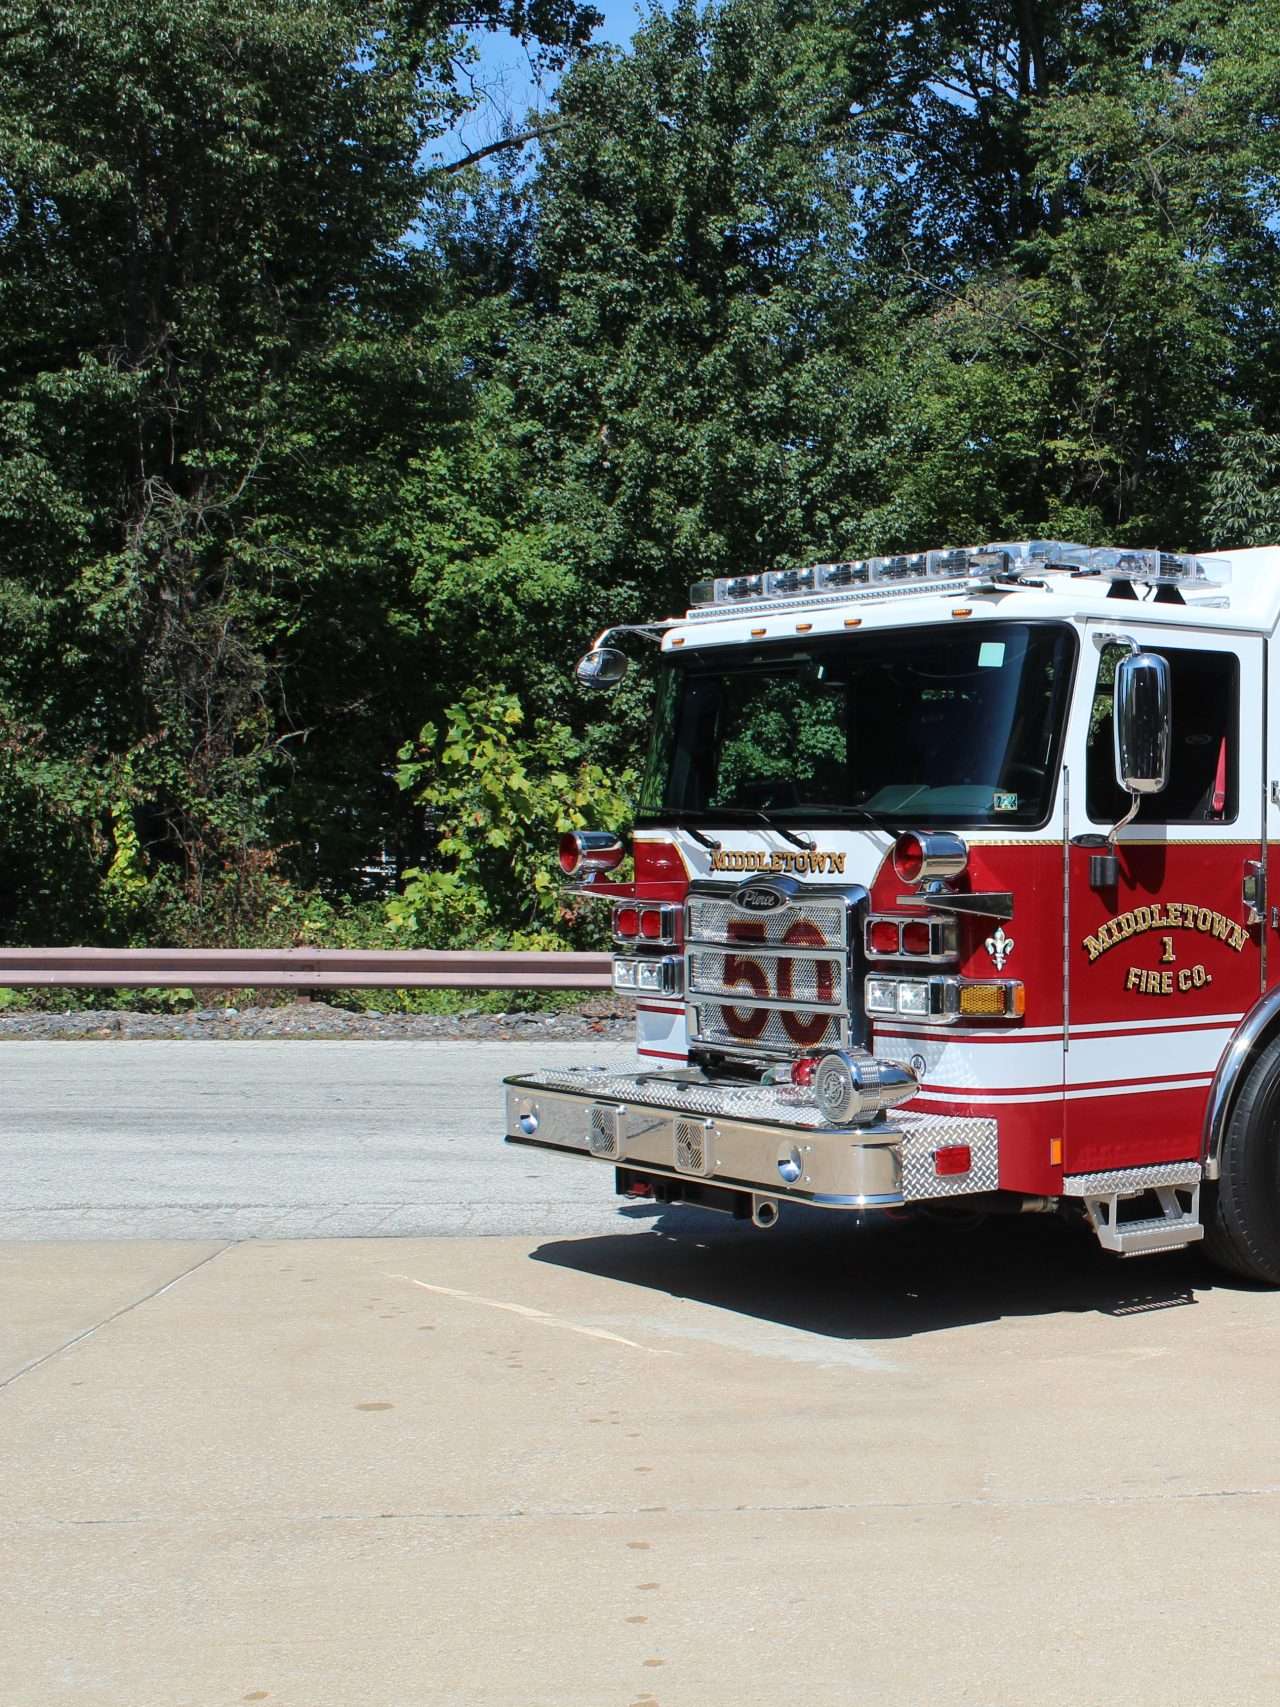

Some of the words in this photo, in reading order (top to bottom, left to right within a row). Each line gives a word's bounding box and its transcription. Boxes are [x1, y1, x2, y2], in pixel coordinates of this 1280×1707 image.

[710, 850, 847, 874] MIDDLETOWN
[742, 889, 776, 907] Pierce
[1082, 902, 1250, 961] MIDDLETOWN
[1161, 936, 1177, 962] 1
[720, 916, 835, 1048] 50
[1126, 956, 1174, 994] FIRE
[1178, 964, 1213, 992] CO.
